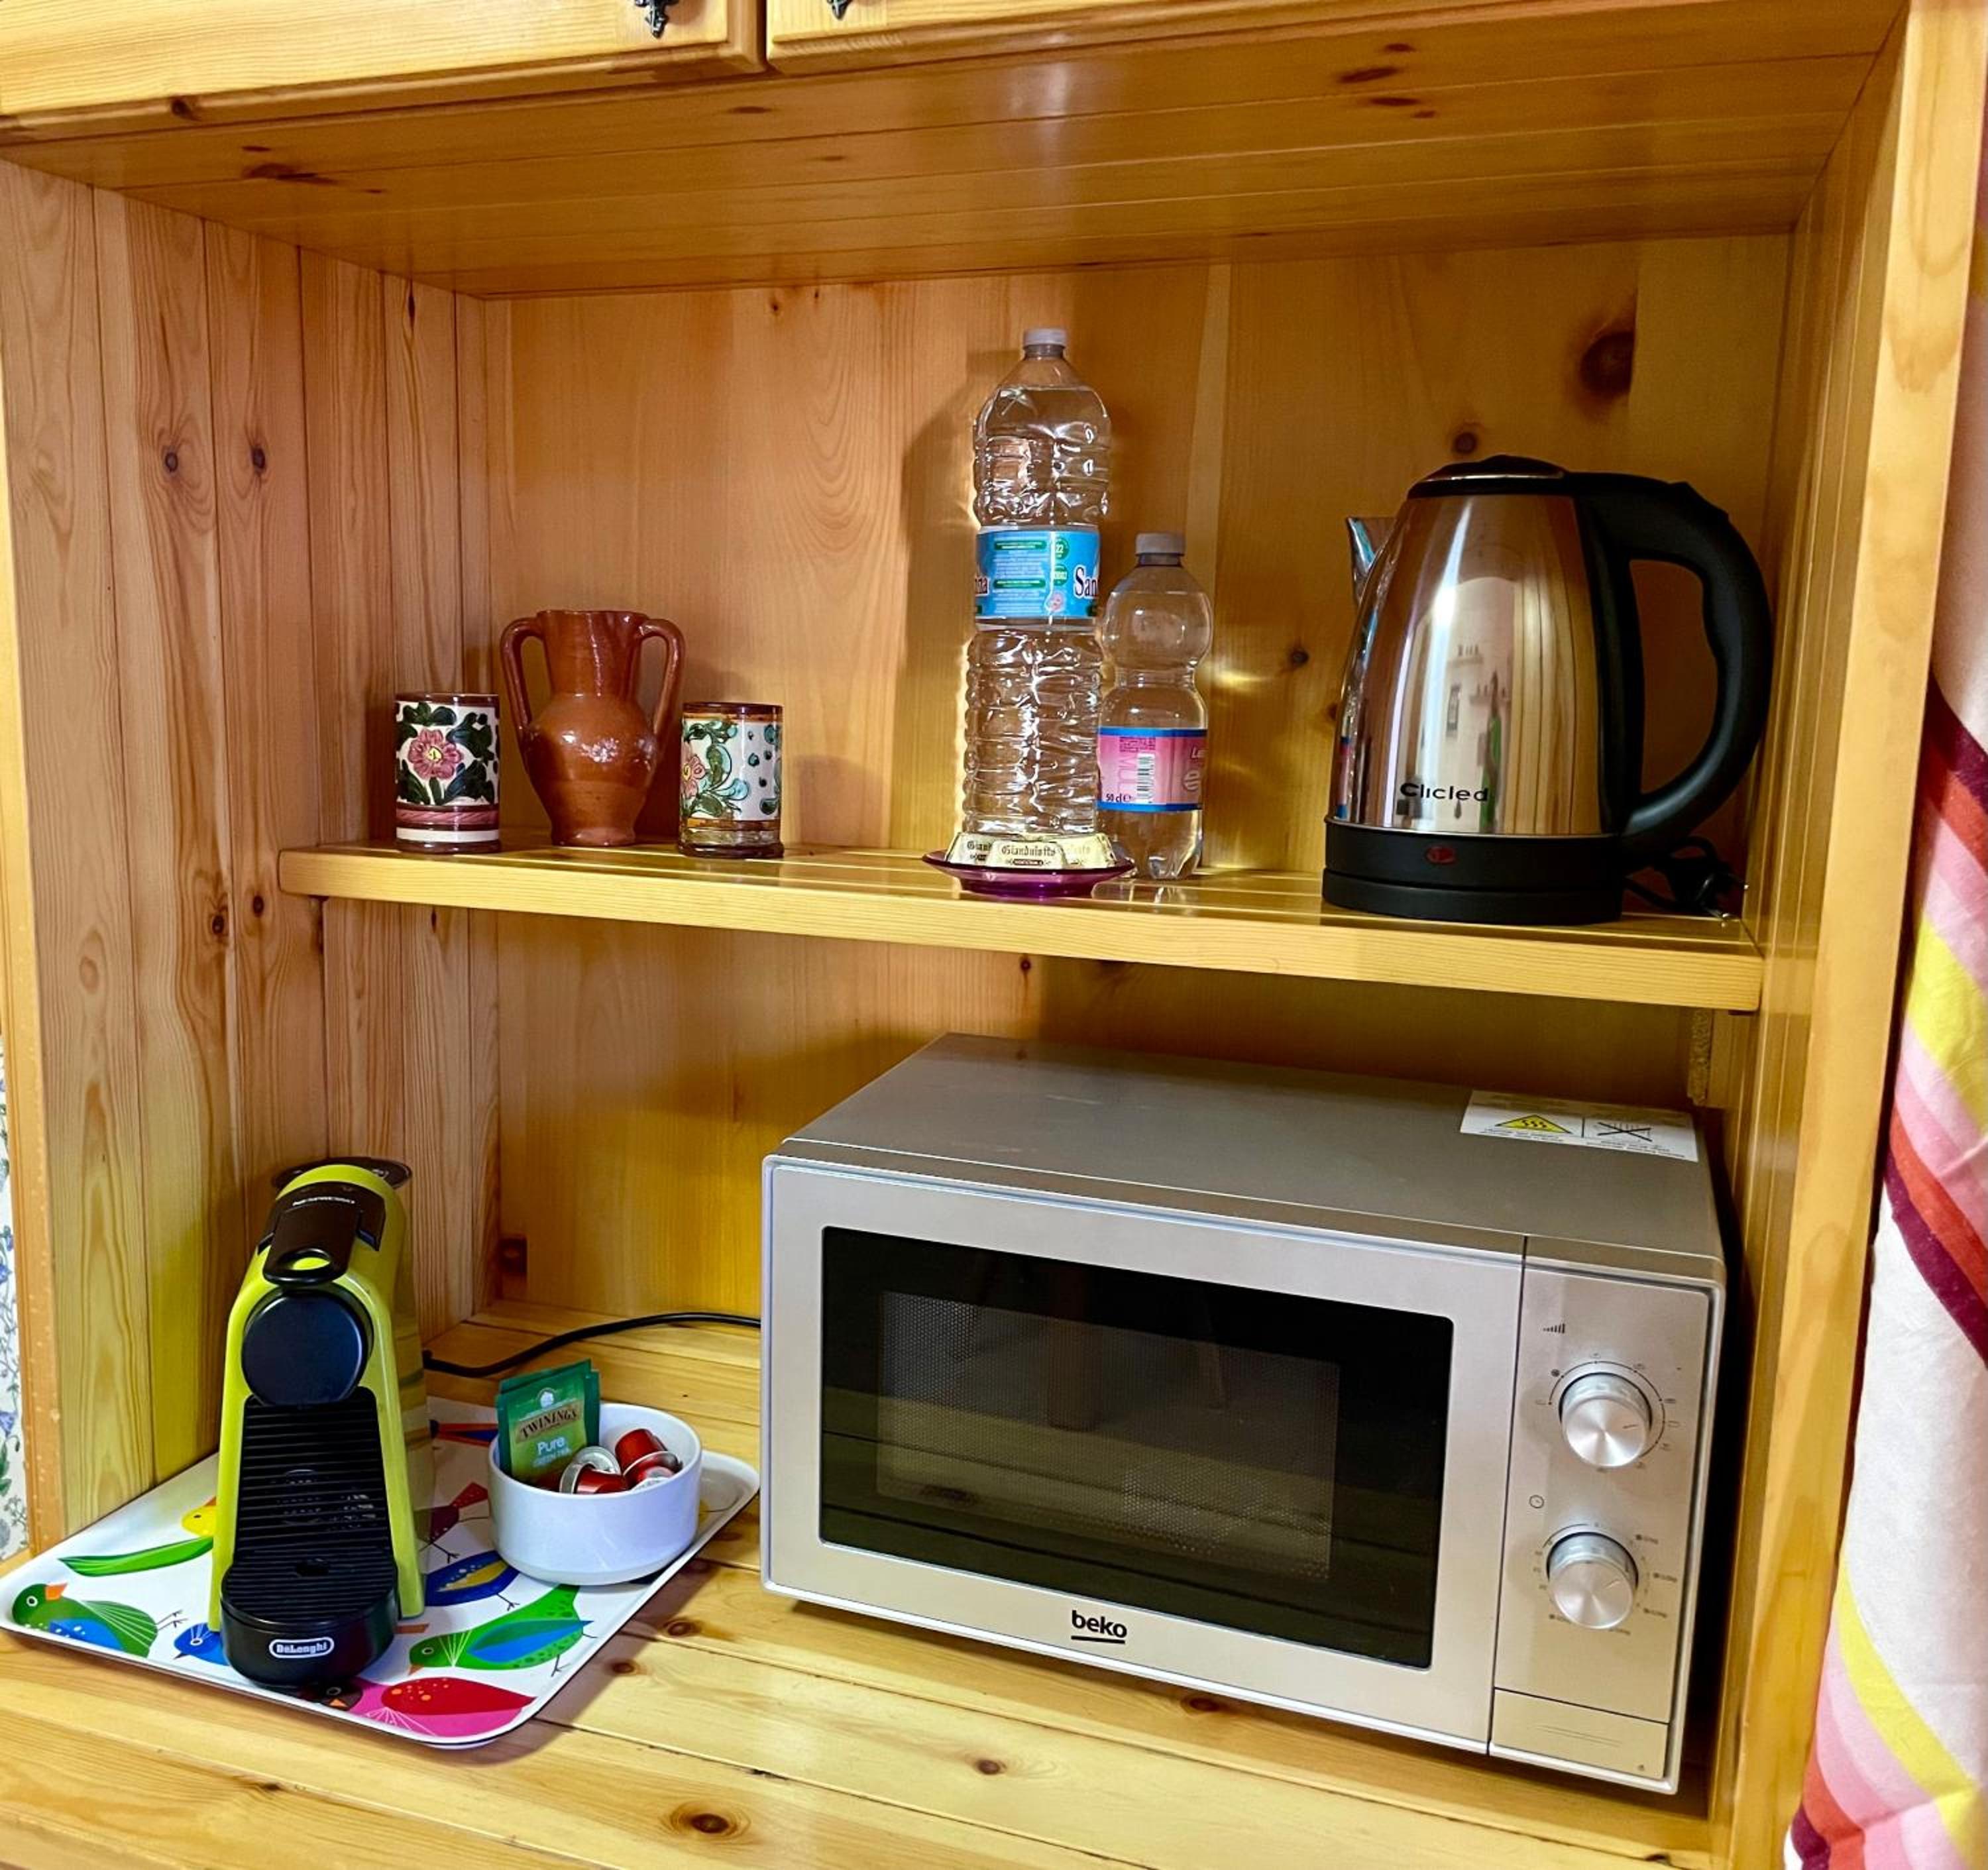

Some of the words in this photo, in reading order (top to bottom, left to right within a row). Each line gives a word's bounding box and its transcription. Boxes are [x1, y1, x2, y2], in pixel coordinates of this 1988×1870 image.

[1400, 783, 1488, 801] Clicled
[537, 1437, 565, 1455] Pure
[1072, 1610, 1127, 1638] beko
[276, 1641, 327, 1654] DeLonghi
